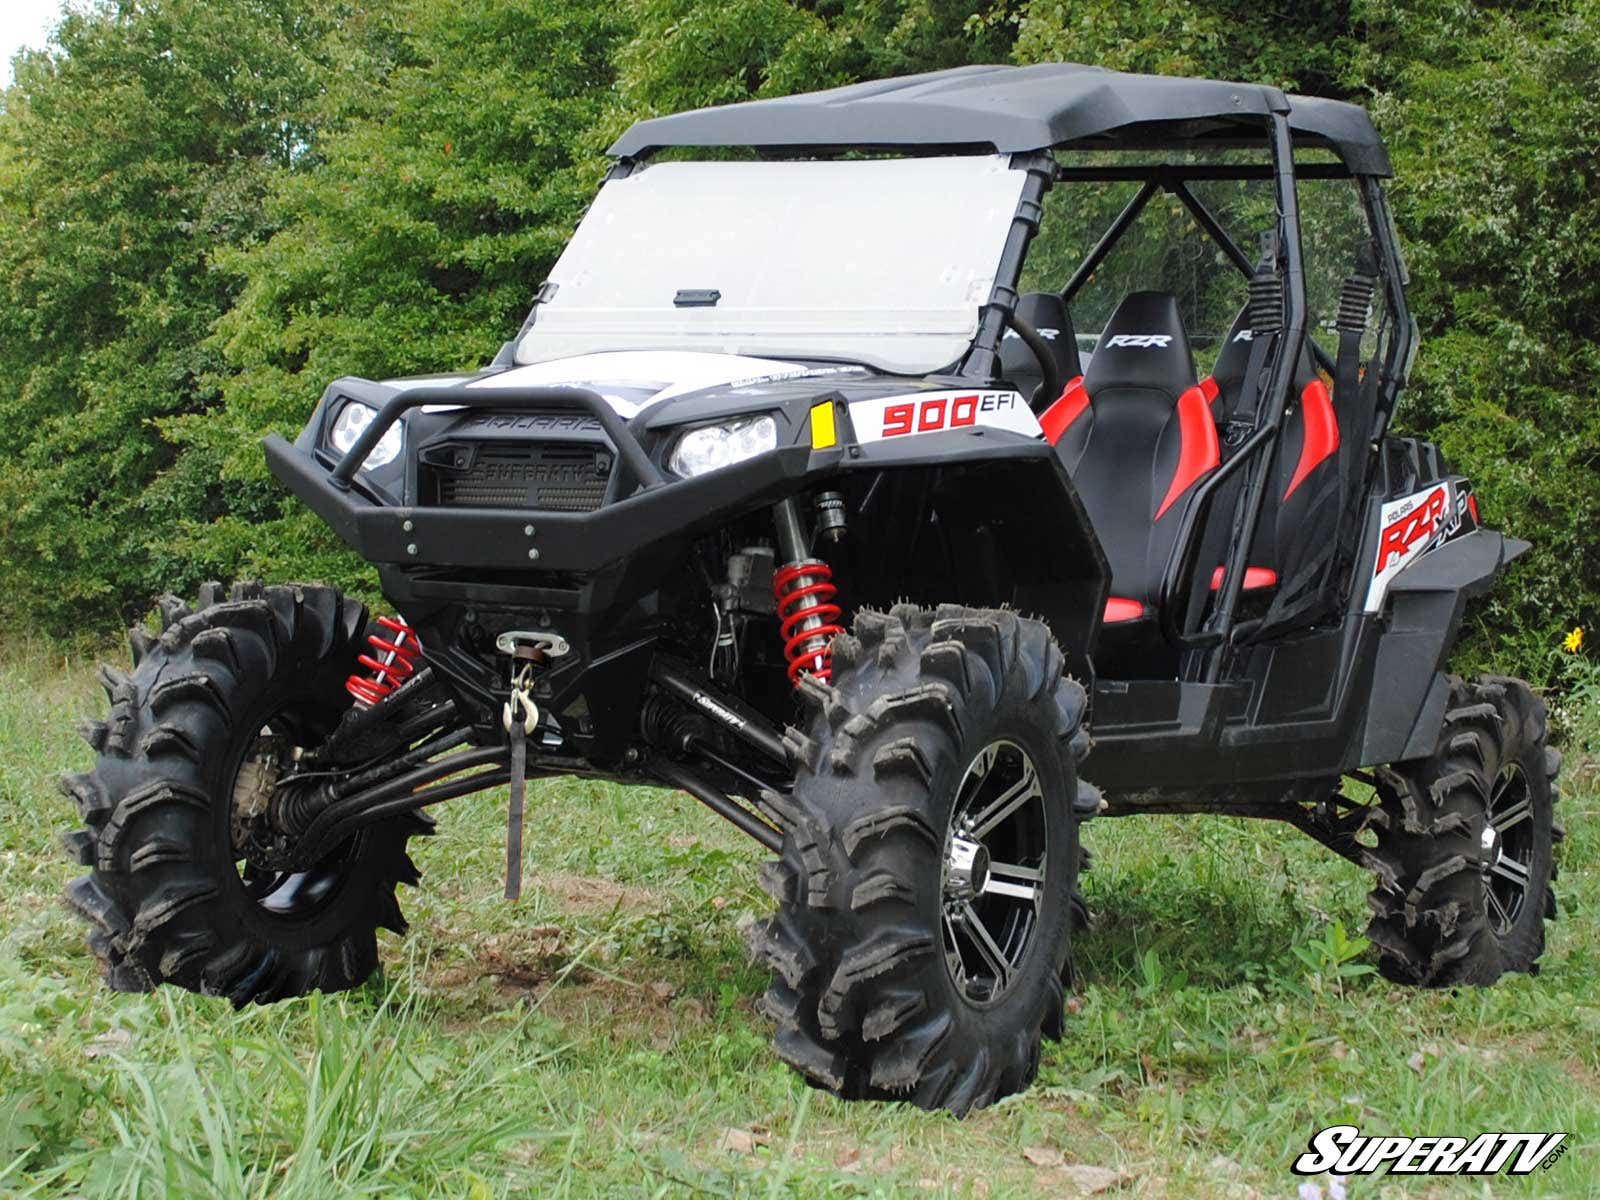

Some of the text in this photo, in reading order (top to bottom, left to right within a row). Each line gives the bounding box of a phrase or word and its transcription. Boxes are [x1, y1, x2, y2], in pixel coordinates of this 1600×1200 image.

[1105, 334, 1173, 349] RZR
[882, 393, 1015, 437] 900 EFI
[1387, 500, 1414, 522] POLARIS
[1376, 487, 1446, 575] RZR
